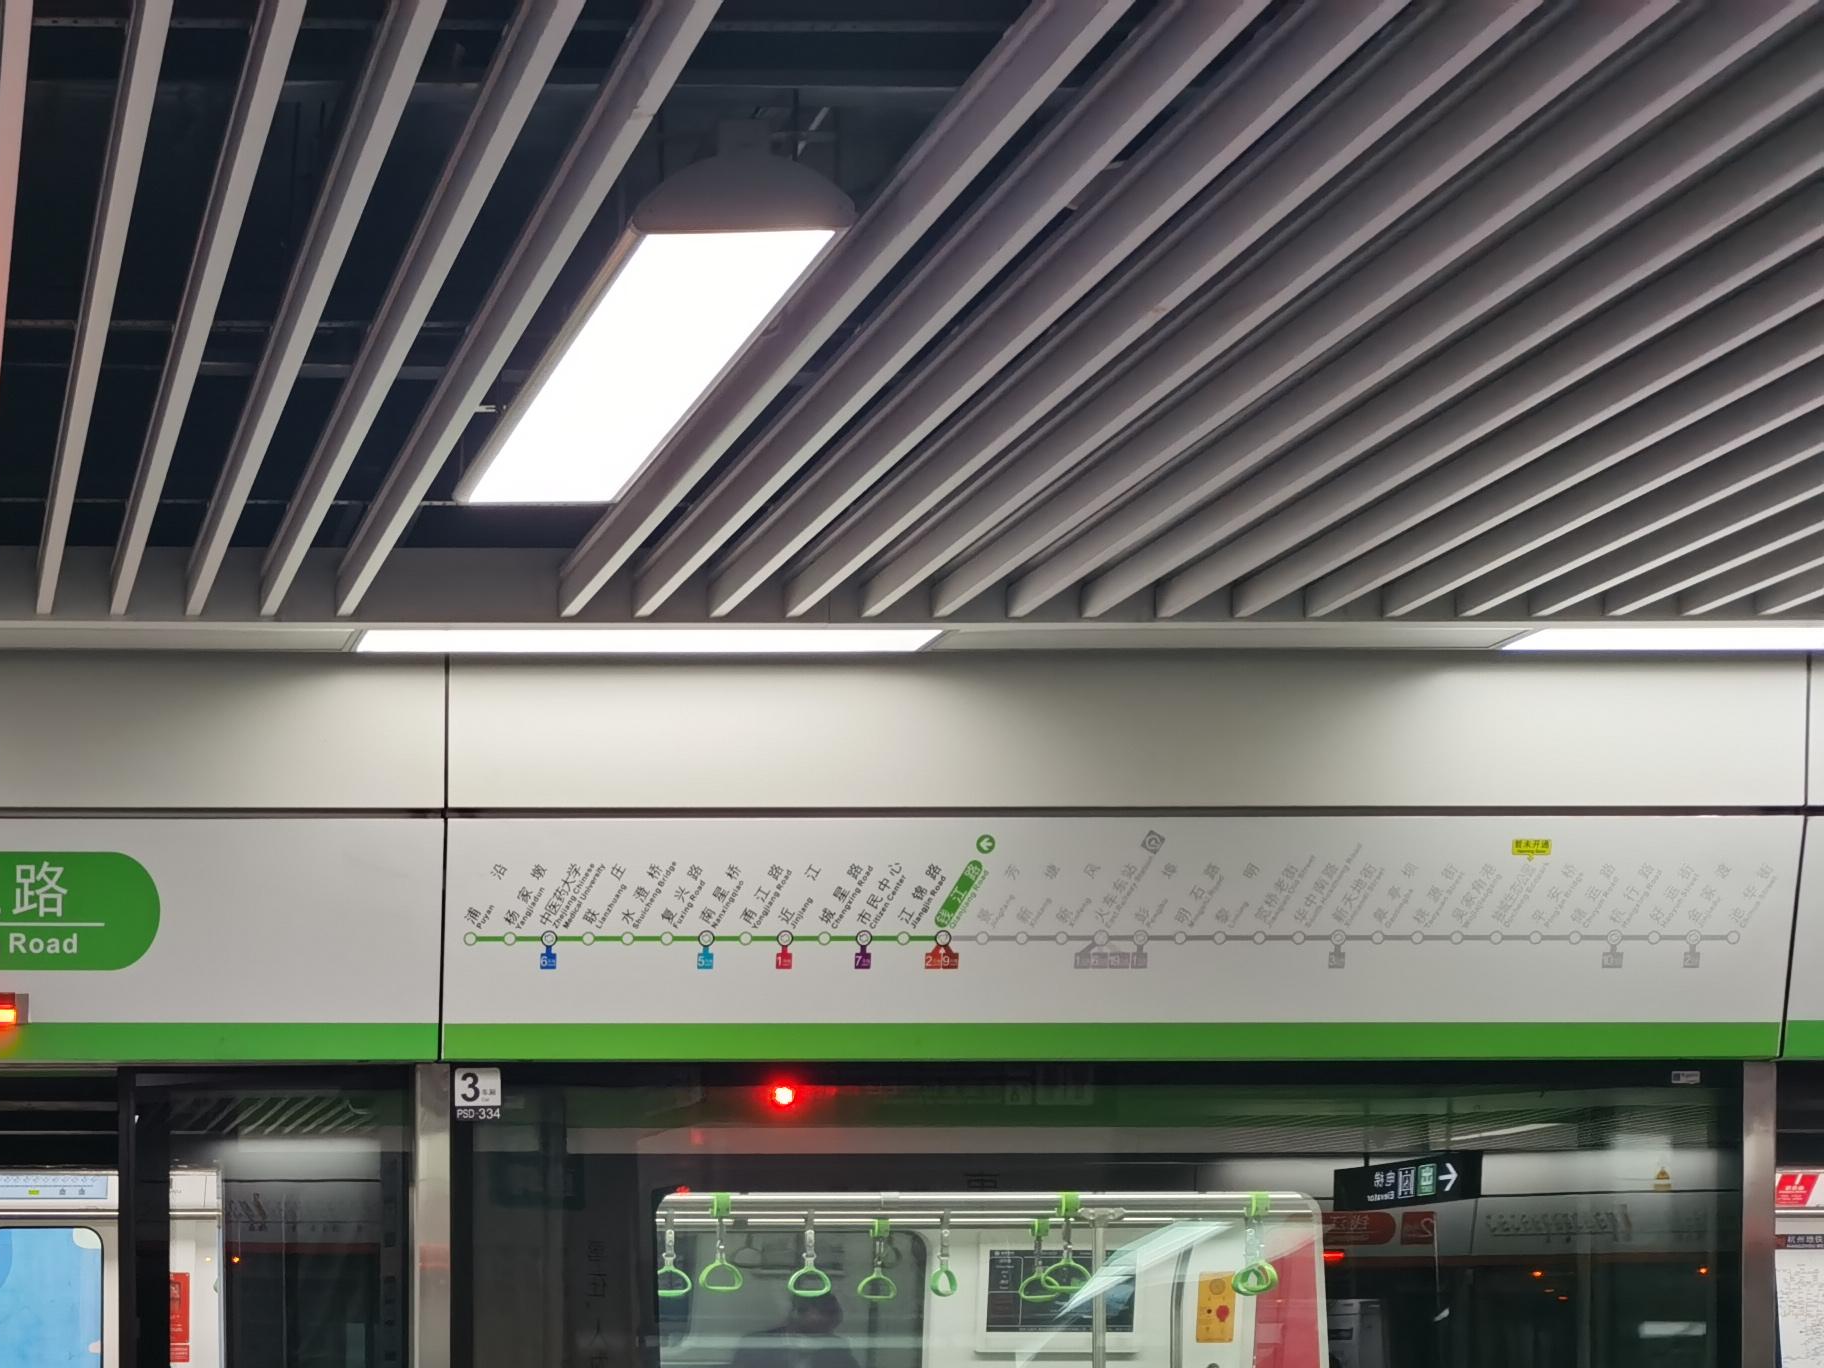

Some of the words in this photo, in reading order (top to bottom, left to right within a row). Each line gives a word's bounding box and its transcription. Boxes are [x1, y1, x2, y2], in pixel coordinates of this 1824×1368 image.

[540, 863, 582, 926] 中医药大学
[562, 900, 583, 930] Medical
[856, 862, 903, 925] 市民中心
[897, 863, 942, 924] 江锦路
[8, 932, 78, 954] Road
[461, 1072, 480, 1102] 3
